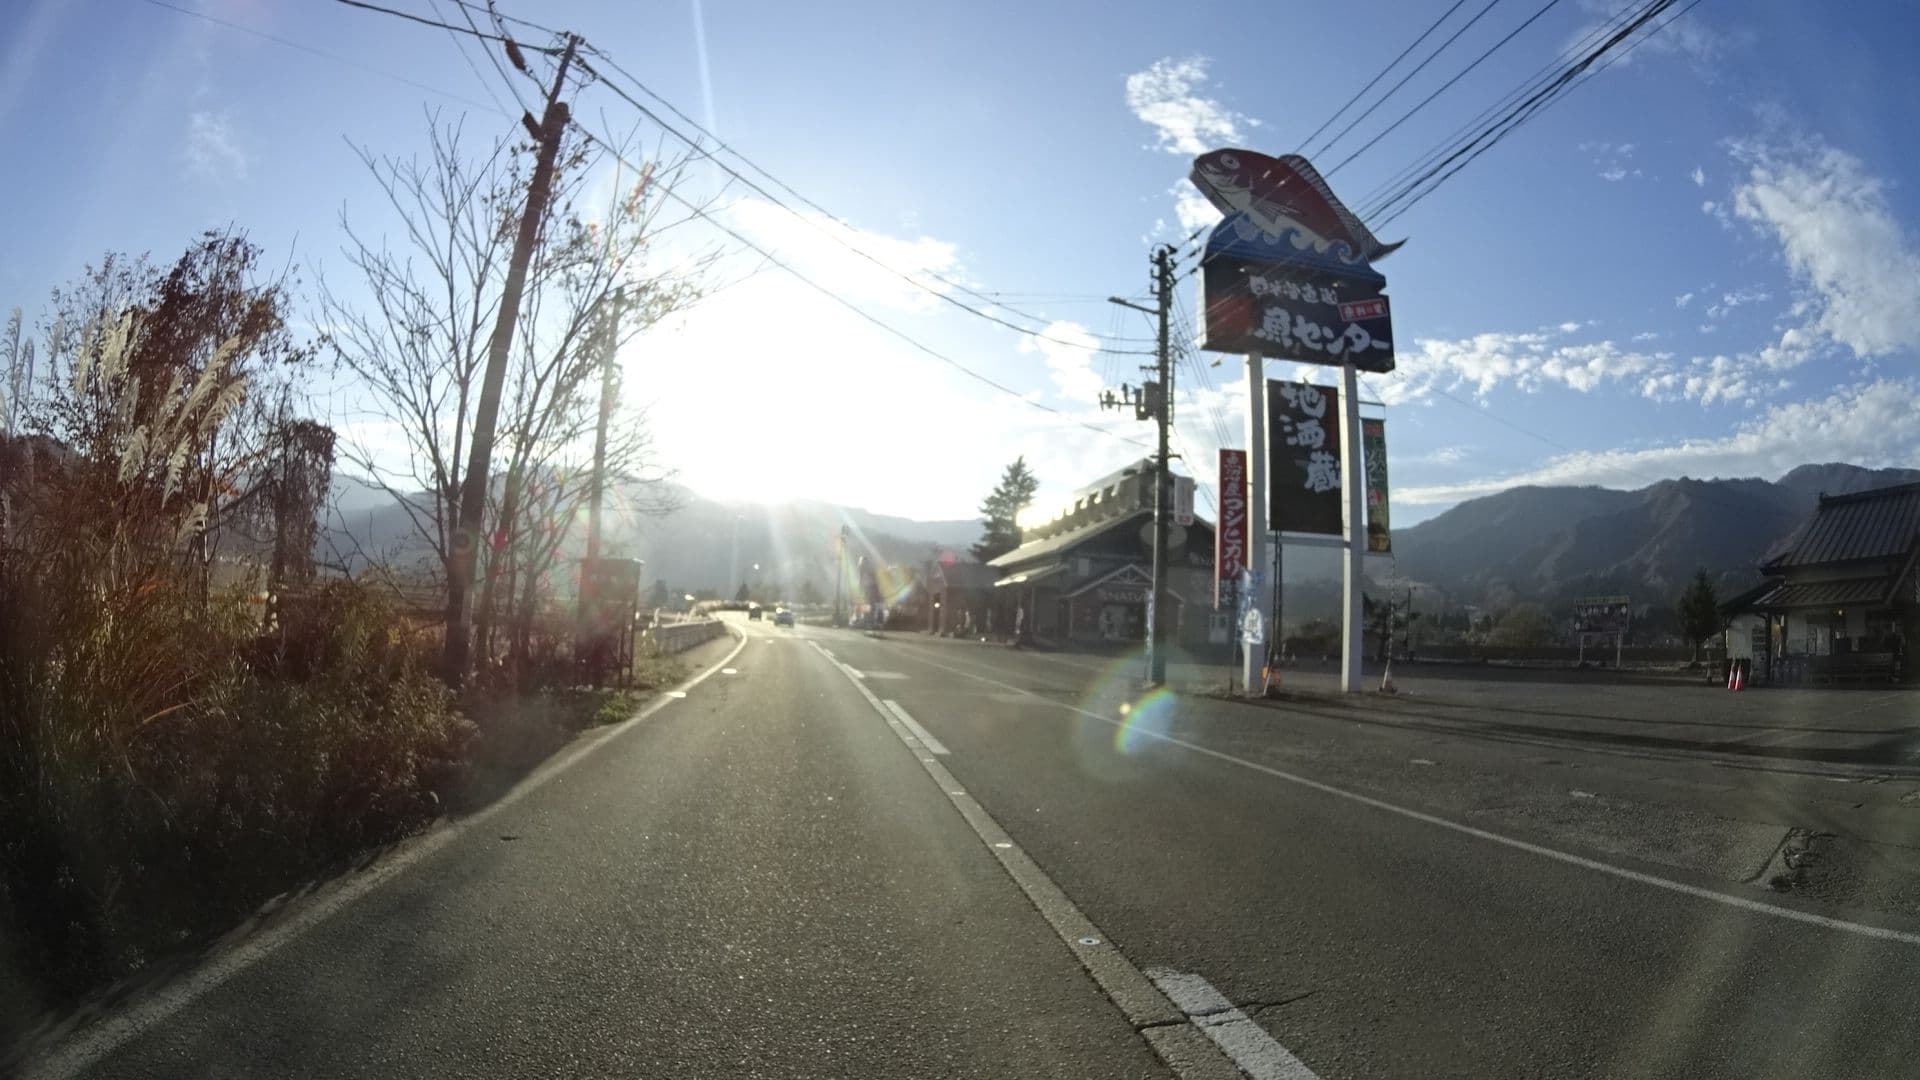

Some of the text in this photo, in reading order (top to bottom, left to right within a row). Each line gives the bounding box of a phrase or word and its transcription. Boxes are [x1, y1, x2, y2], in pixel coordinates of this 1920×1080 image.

[1254, 306, 1390, 354] 魚センター
[1279, 376, 1341, 493] 地酒蔵
